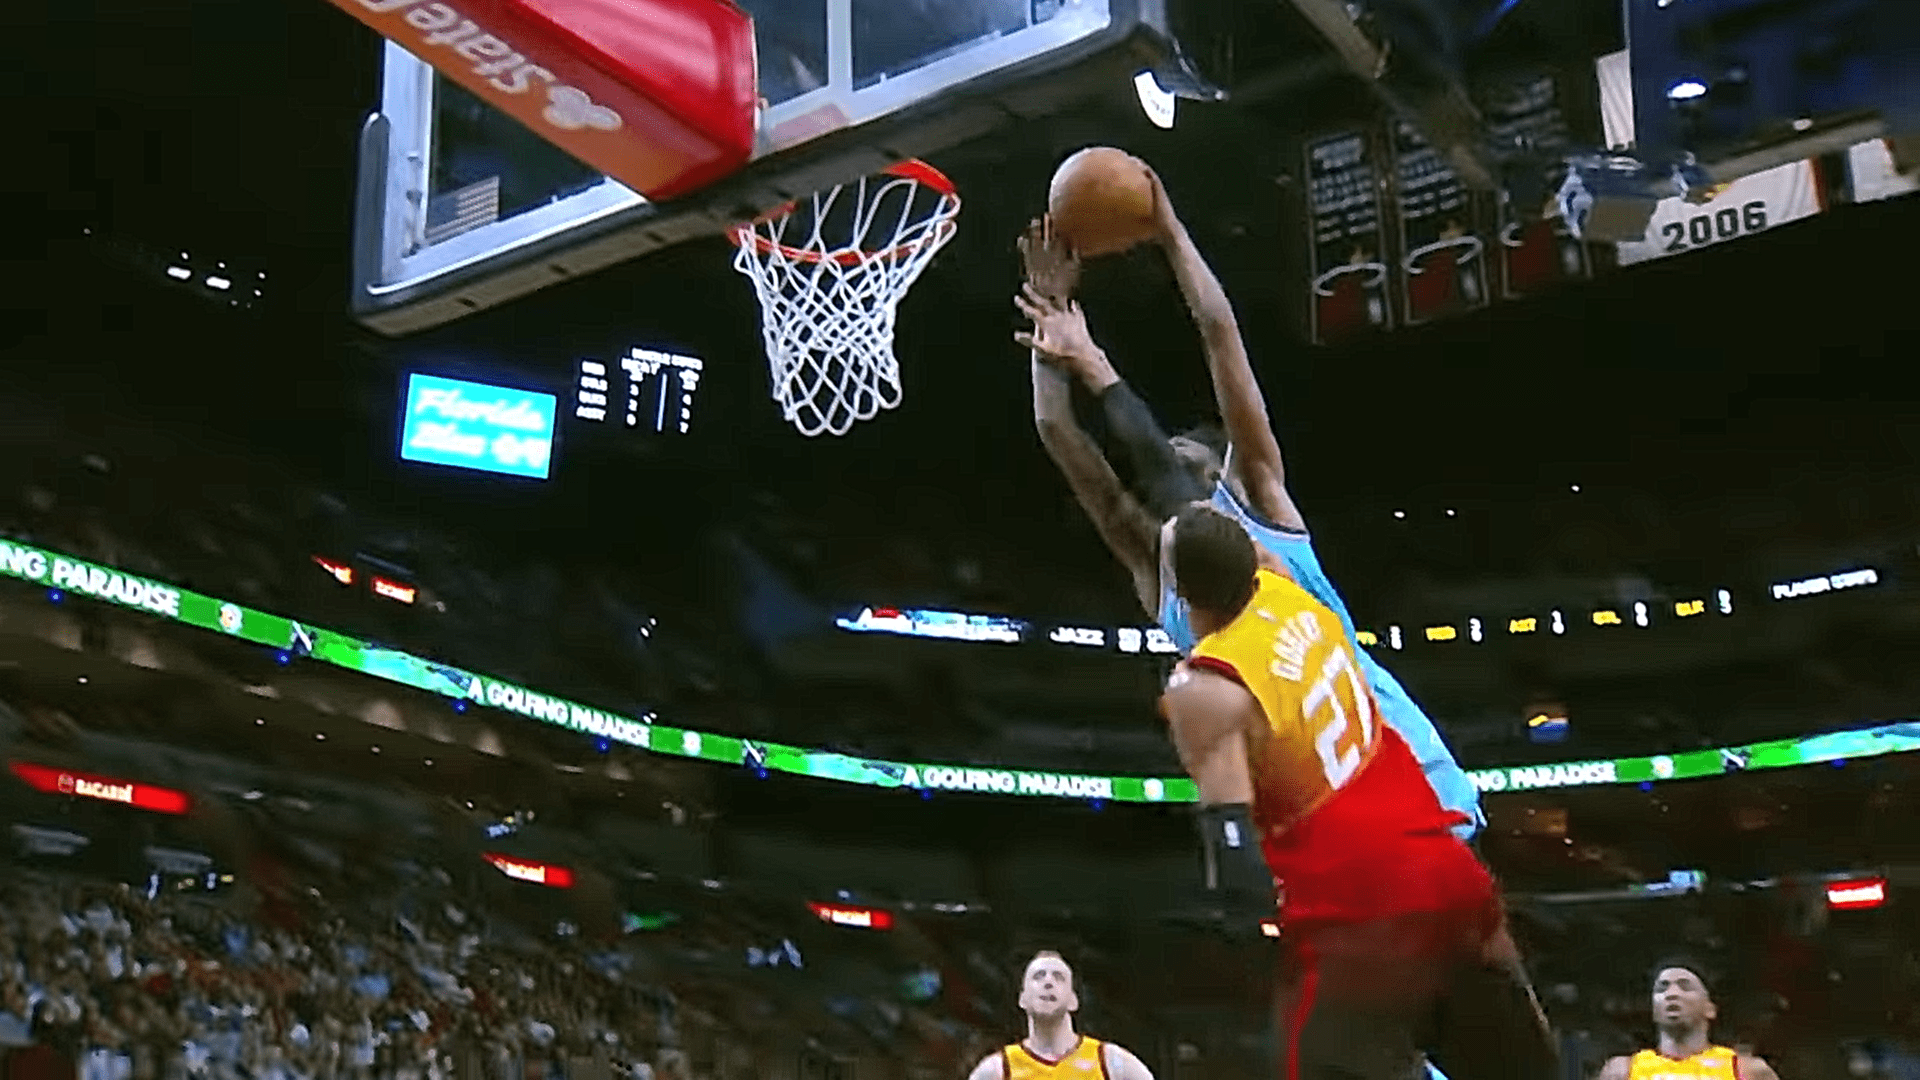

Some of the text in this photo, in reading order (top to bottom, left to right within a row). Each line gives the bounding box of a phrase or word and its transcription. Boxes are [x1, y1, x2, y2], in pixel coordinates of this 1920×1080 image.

[1662, 200, 1767, 252] 2006
[53, 558, 181, 617] PARADISE
[1050, 626, 1104, 646] JAZZ
[467, 677, 651, 748] A GOLFING PARADISE
[1303, 645, 1373, 791] 27
[903, 766, 1112, 798] A GOLFING PARADISE
[1510, 762, 1617, 789] PARADISE
